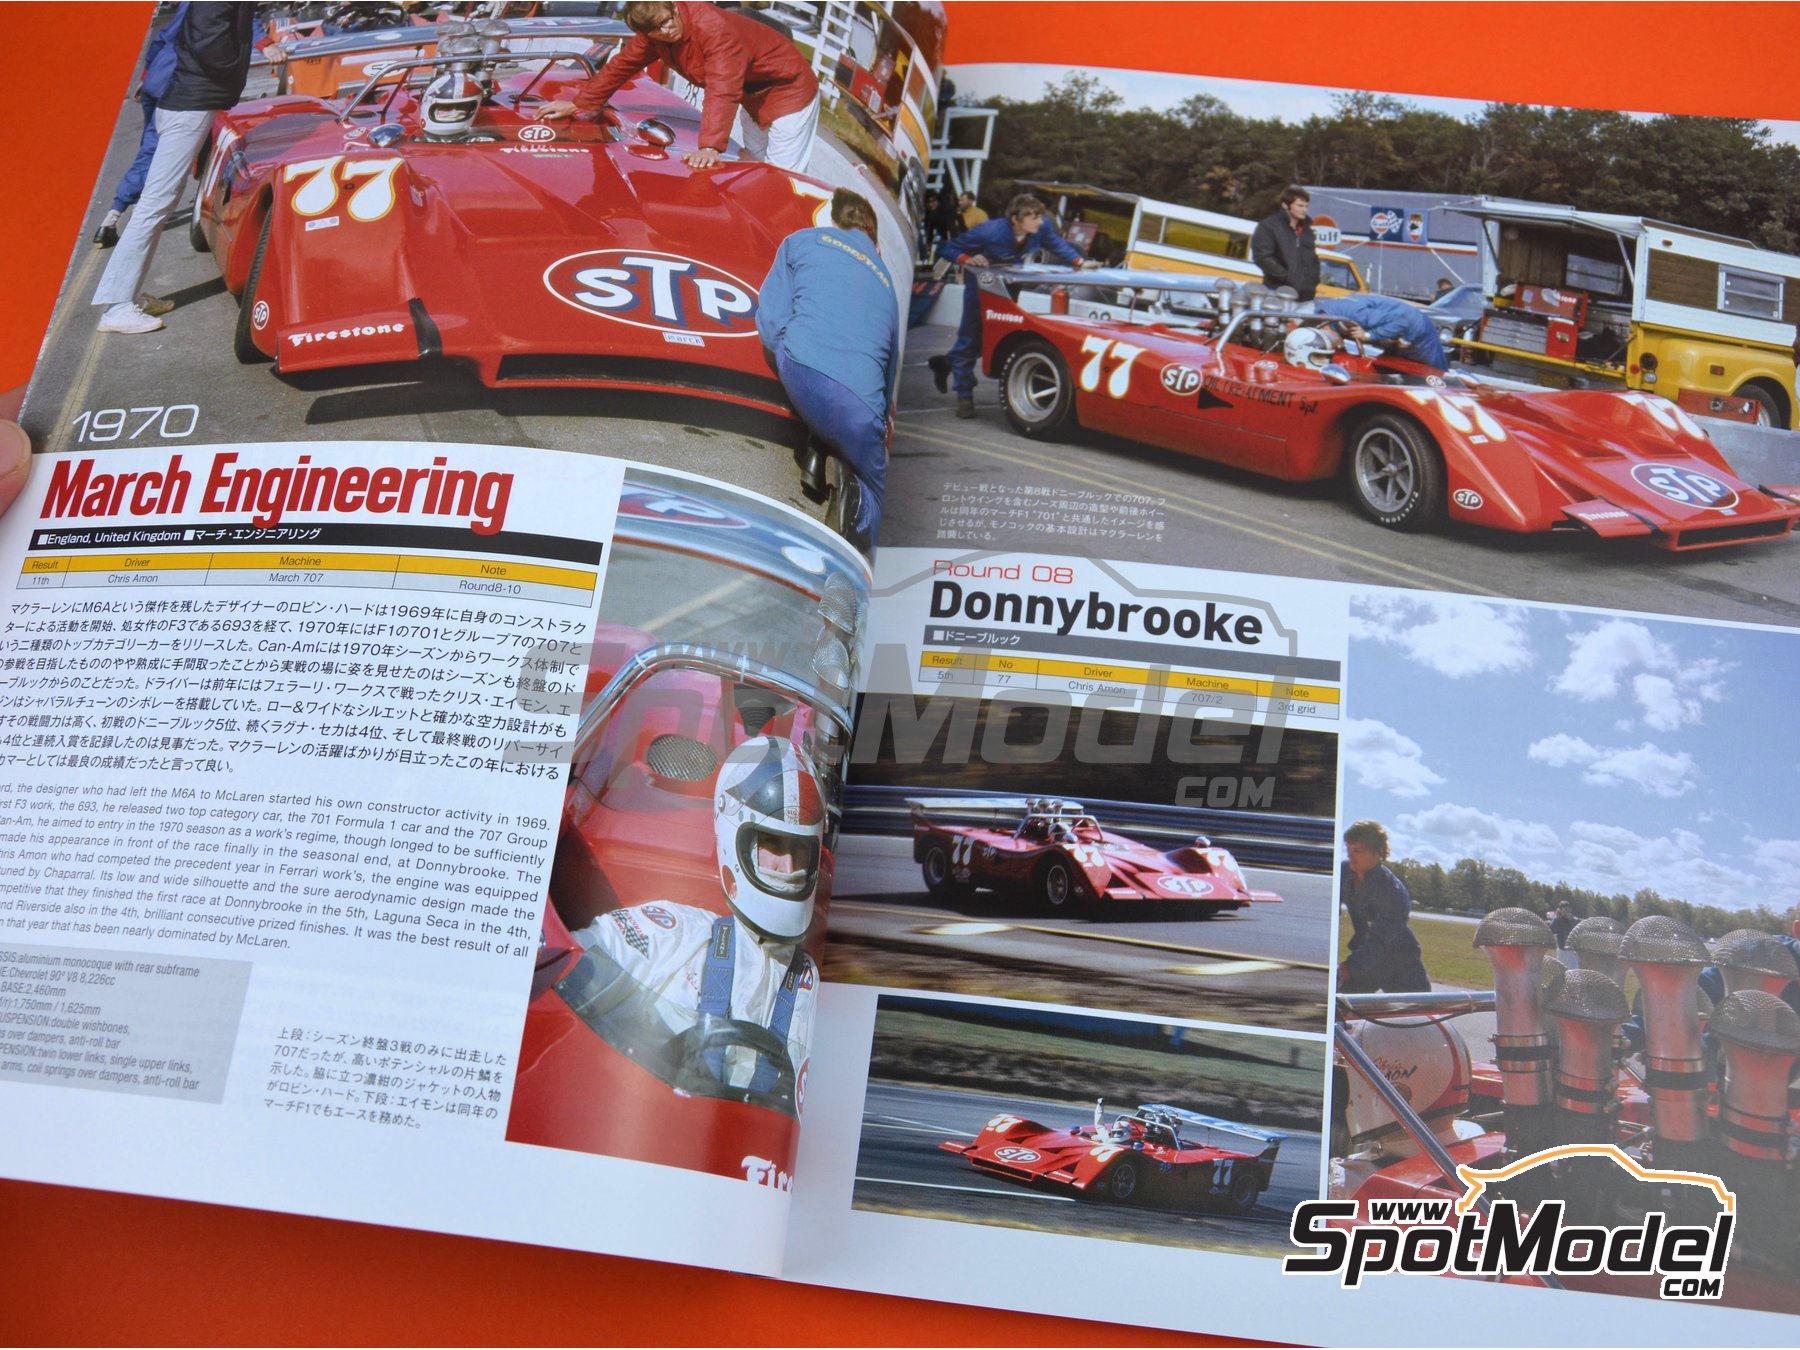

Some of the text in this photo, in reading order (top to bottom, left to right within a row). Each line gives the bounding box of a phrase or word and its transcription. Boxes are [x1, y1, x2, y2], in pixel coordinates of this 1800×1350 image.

[283, 156, 405, 222] 77
[574, 255, 757, 327] STP
[985, 309, 1024, 323] Firestone
[288, 323, 406, 346] Firestone
[1080, 335, 1147, 398] 77
[1163, 365, 1199, 391] STP
[72, 404, 200, 443] 1970
[39, 452, 514, 535] March Engineering
[1456, 490, 1480, 507] STP
[1648, 466, 1724, 504] STP
[48, 528, 322, 544] England, United Kingdom マーチ・エンジニアリング
[32, 556, 507, 576] Result Driver Machine Note
[933, 559, 1073, 584] Round 08
[32, 572, 521, 594] 11th Chris Amon March 707 Round8-10
[929, 580, 1263, 646] Donnybrooke
[945, 630, 1021, 645] ドニーブルック
[932, 655, 1310, 698] Result No Driver Machine Note
[937, 671, 1316, 714] 5th 77 Chris Amon 707/2 3rd grid
[16, 782, 33, 794] the
[35, 783, 80, 797] designer
[81, 784, 104, 796] who
[105, 784, 128, 797] had
[129, 785, 148, 797] left
[149, 786, 168, 798] the
[170, 786, 196, 799] M6A
[199, 788, 212, 800] to
[214, 788, 265, 803] McLaren
[267, 792, 312, 806] started
[314, 794, 333, 808] his
[336, 798, 363, 810] own
[366, 801, 442, 817] constructor
[444, 808, 494, 826] activity
[496, 812, 510, 825] in
[515, 814, 550, 831] 1969.
[28, 832, 45, 844] his
[47, 834, 110, 847] appearance
[112, 835, 124, 847] in
[126, 835, 154, 849] front
[156, 837, 170, 849] of
[171, 838, 191, 851] the
[193, 842, 220, 853] race
[223, 841, 260, 858] finally
[262, 844, 274, 856] in
[278, 845, 299, 858] the
[301, 849, 360, 863] seasonal
[363, 854, 392, 868] end,
[396, 856, 411, 869] at
[414, 857, 510, 880] Donnybrooke.
[516, 869, 542, 885] The
[5, 916, 27, 929] that
[25, 919, 50, 932] year
[50, 919, 72, 932] that
[71, 920, 92, 933] has
[92, 921, 120, 935] been
[121, 925, 156, 940] nearly
[156, 926, 217, 943] dominated
[217, 930, 234, 947] by
[234, 931, 291, 949] McLaren.
[63, 957, 112, 971] monocoque
[115, 961, 133, 972] with
[135, 964, 154, 973] rear
[155, 964, 200, 977] subframe
[66, 972, 79, 983] V8
